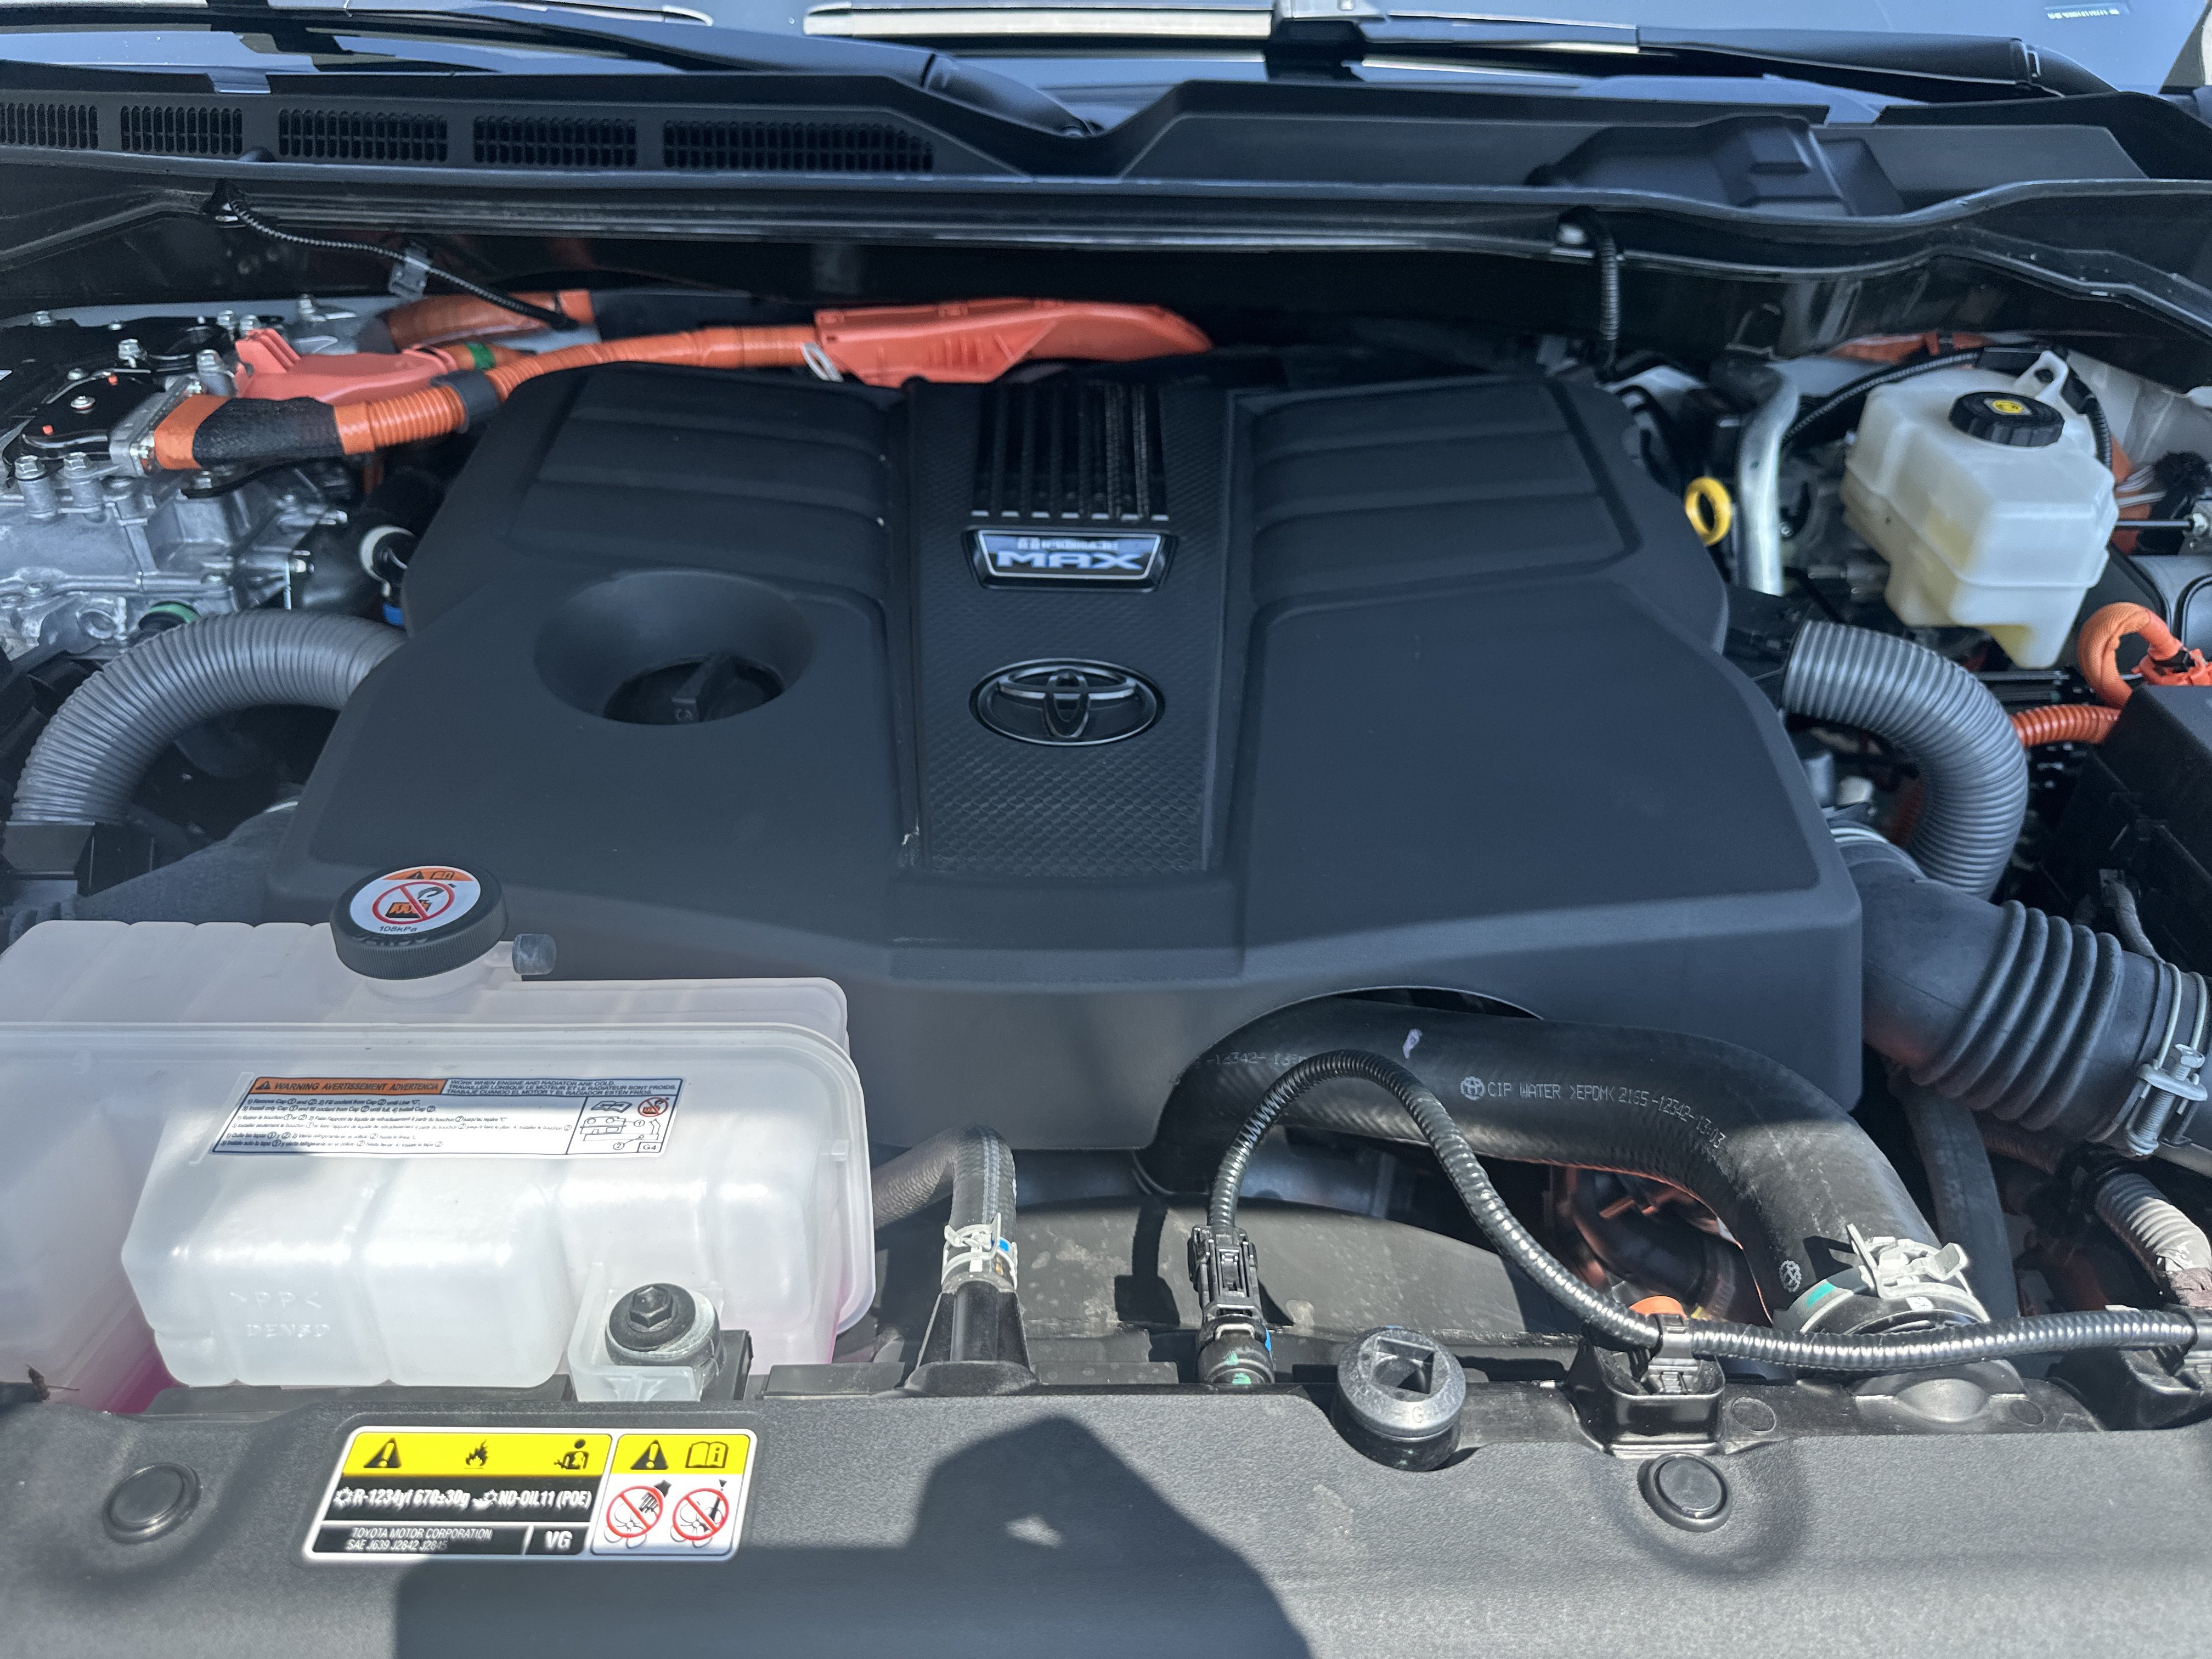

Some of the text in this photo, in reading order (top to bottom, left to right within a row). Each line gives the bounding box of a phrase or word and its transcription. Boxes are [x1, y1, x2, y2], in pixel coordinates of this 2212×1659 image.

[996, 550, 1143, 570] MAX
[1487, 1082, 1512, 1097] CIP
[1519, 1083, 1561, 1099] WATER
[352, 1488, 414, 1509] R-1234yf
[414, 1489, 471, 1509] 670±30g
[555, 1490, 592, 1510] (POE)
[352, 1527, 493, 1541] TOYOTA MOTOR CORPORATION
[545, 1531, 573, 1550] VG
[346, 1539, 366, 1550] SAE
[366, 1539, 391, 1550] J639
[391, 1540, 419, 1551] J2842
